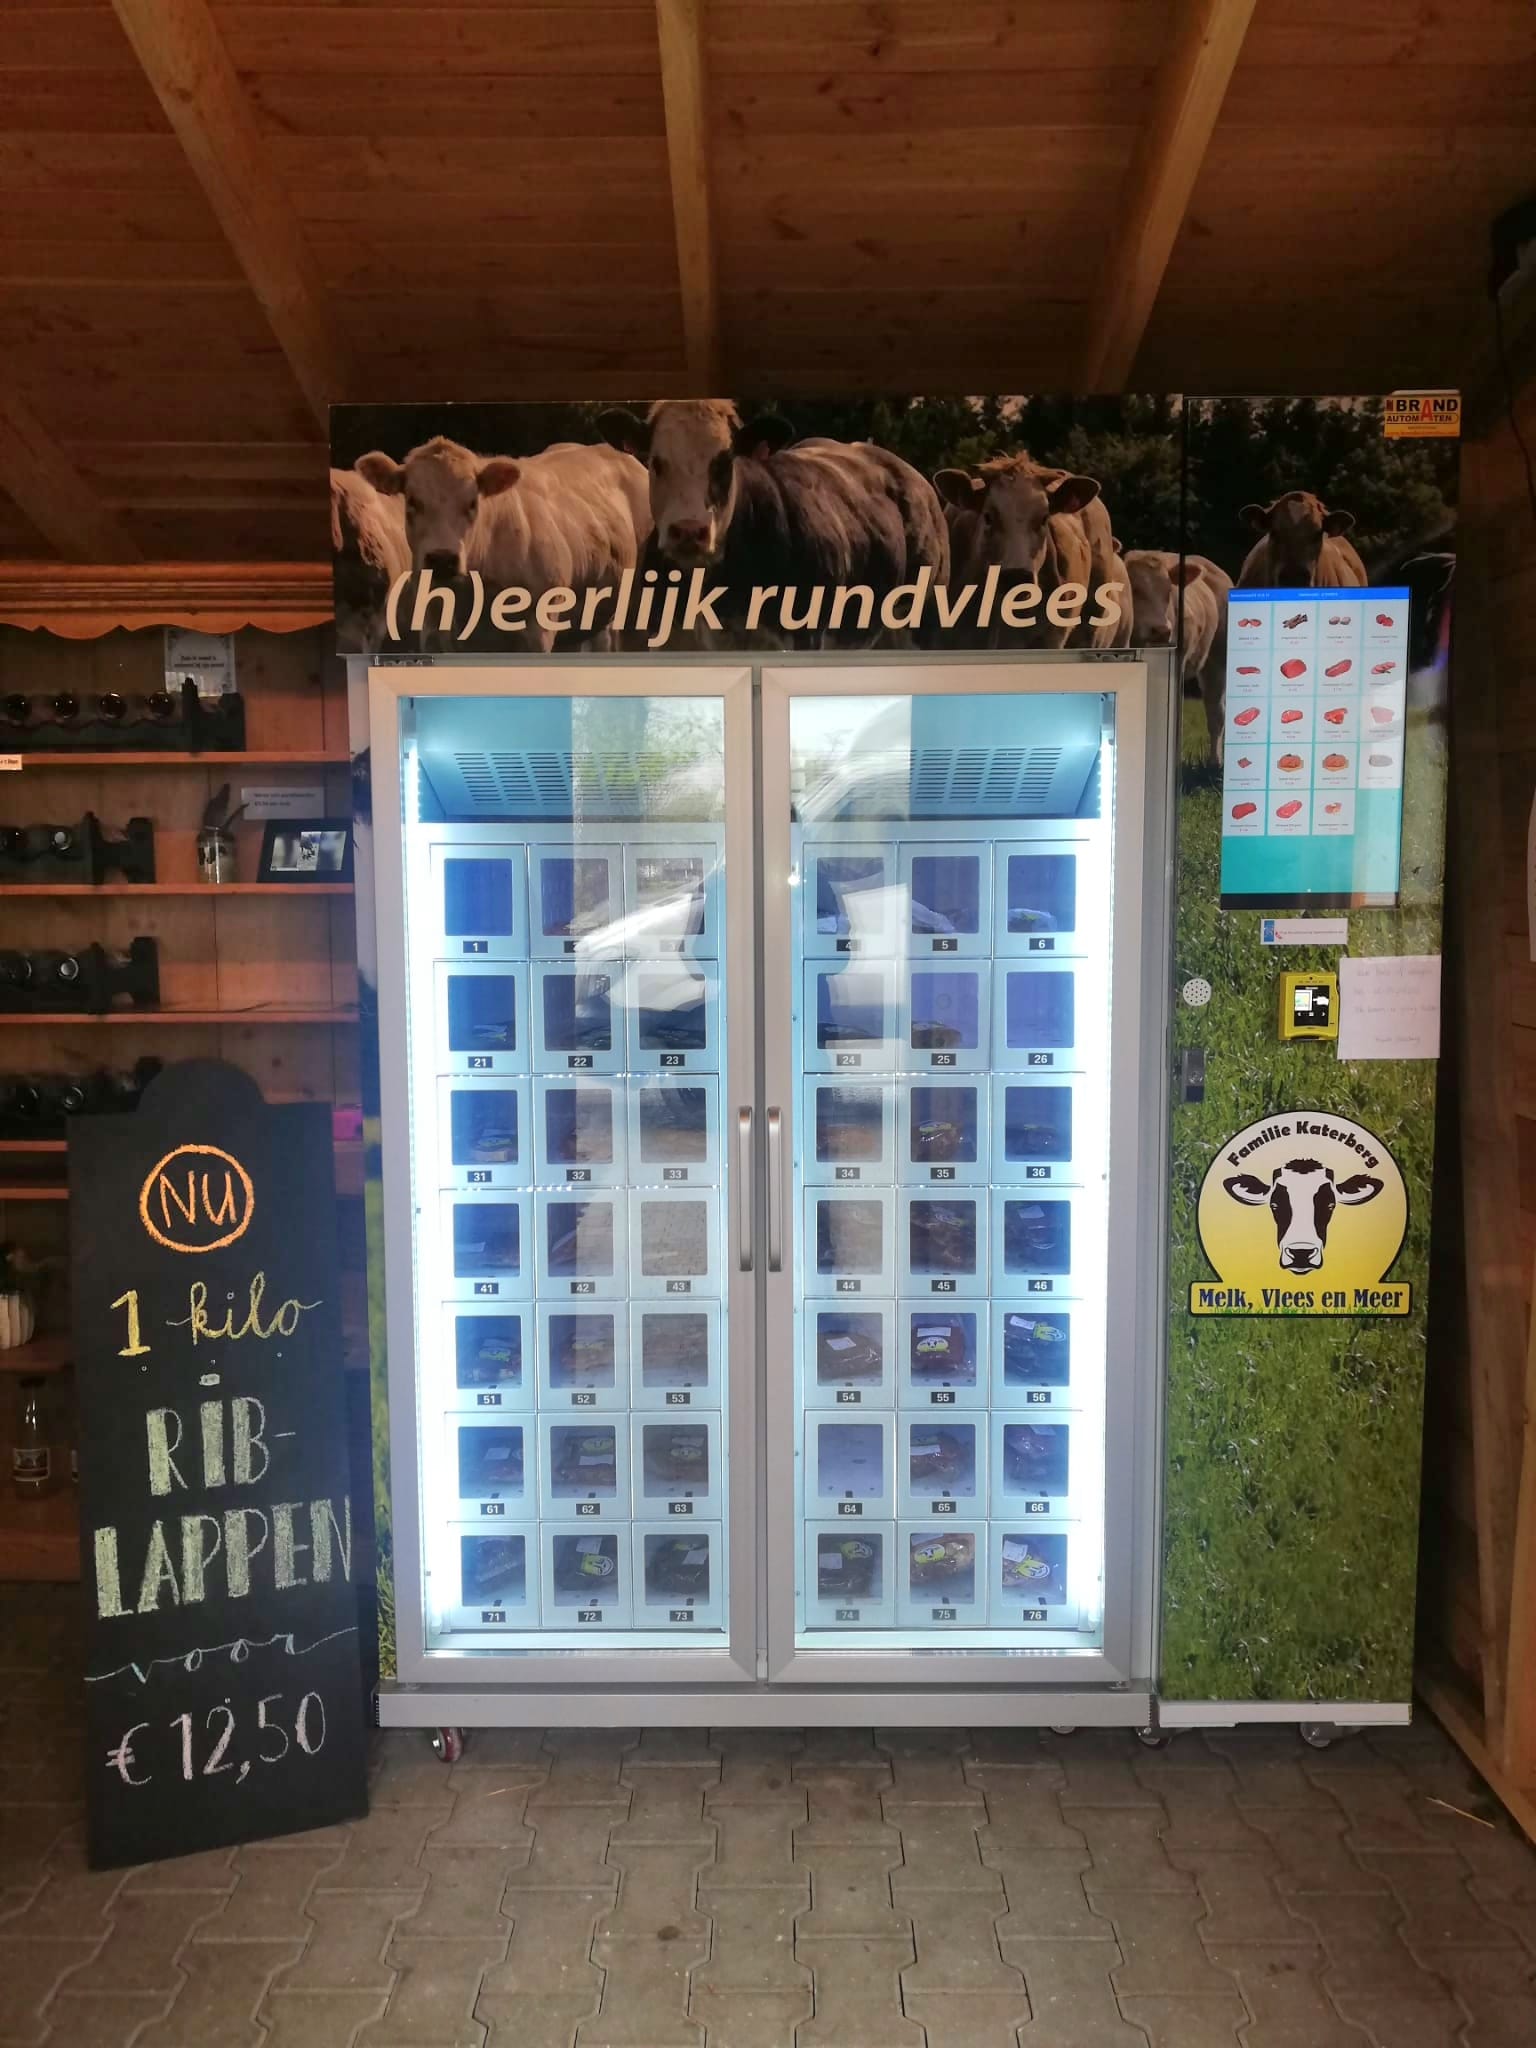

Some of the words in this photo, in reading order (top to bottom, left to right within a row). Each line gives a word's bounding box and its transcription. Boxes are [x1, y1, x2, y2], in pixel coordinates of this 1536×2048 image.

[1396, 399, 1459, 412] BRAND
[386, 567, 729, 647] (h)eerlijk
[745, 565, 1125, 630] rundvlees
[474, 1058, 487, 1066] 21
[574, 1057, 587, 1066] 22
[666, 1056, 679, 1065] 23
[842, 1056, 855, 1065] 24
[937, 1056, 950, 1064] 25
[1034, 1055, 1047, 1064] 26
[1226, 1124, 1291, 1167] Familie
[1296, 1120, 1380, 1169] Katerberg
[473, 1172, 486, 1181] 31
[572, 1171, 585, 1180] 32
[669, 1170, 682, 1178] 33
[842, 1170, 854, 1178] 34
[936, 1170, 949, 1178] 35
[1032, 1168, 1045, 1177] 36
[159, 1170, 238, 1229] NU
[480, 1285, 493, 1293] 41
[576, 1284, 589, 1292] 42
[672, 1283, 685, 1291] 43
[842, 1282, 855, 1290] 44
[937, 1282, 950, 1290] 45
[1034, 1281, 1047, 1290] 46
[1198, 1288, 1254, 1310] Melk,
[1262, 1288, 1315, 1308] Vlees
[1321, 1292, 1347, 1308] en
[1353, 1288, 1403, 1308] Meer
[110, 1290, 151, 1356] 1
[166, 1271, 324, 1346] kilo
[483, 1395, 496, 1404] 51
[577, 1395, 590, 1403] 52
[672, 1394, 684, 1403] 53
[842, 1393, 855, 1401] 54
[937, 1394, 949, 1402] 55
[1033, 1394, 1045, 1402] 56
[486, 1505, 499, 1513] 61
[582, 1505, 594, 1513] 62
[674, 1504, 687, 1513] 63
[844, 1505, 856, 1513] 64
[938, 1504, 950, 1512] 65
[1031, 1504, 1044, 1512] 66
[94, 1494, 352, 1620] LAPPEN
[488, 1613, 500, 1621] 71
[584, 1612, 596, 1621] 72
[676, 1612, 688, 1620] 73
[842, 1611, 854, 1619] 74
[938, 1610, 950, 1619] 75
[1029, 1612, 1042, 1620] 76
[84, 1626, 358, 1685] voor
[169, 1691, 327, 1785] 12,50
